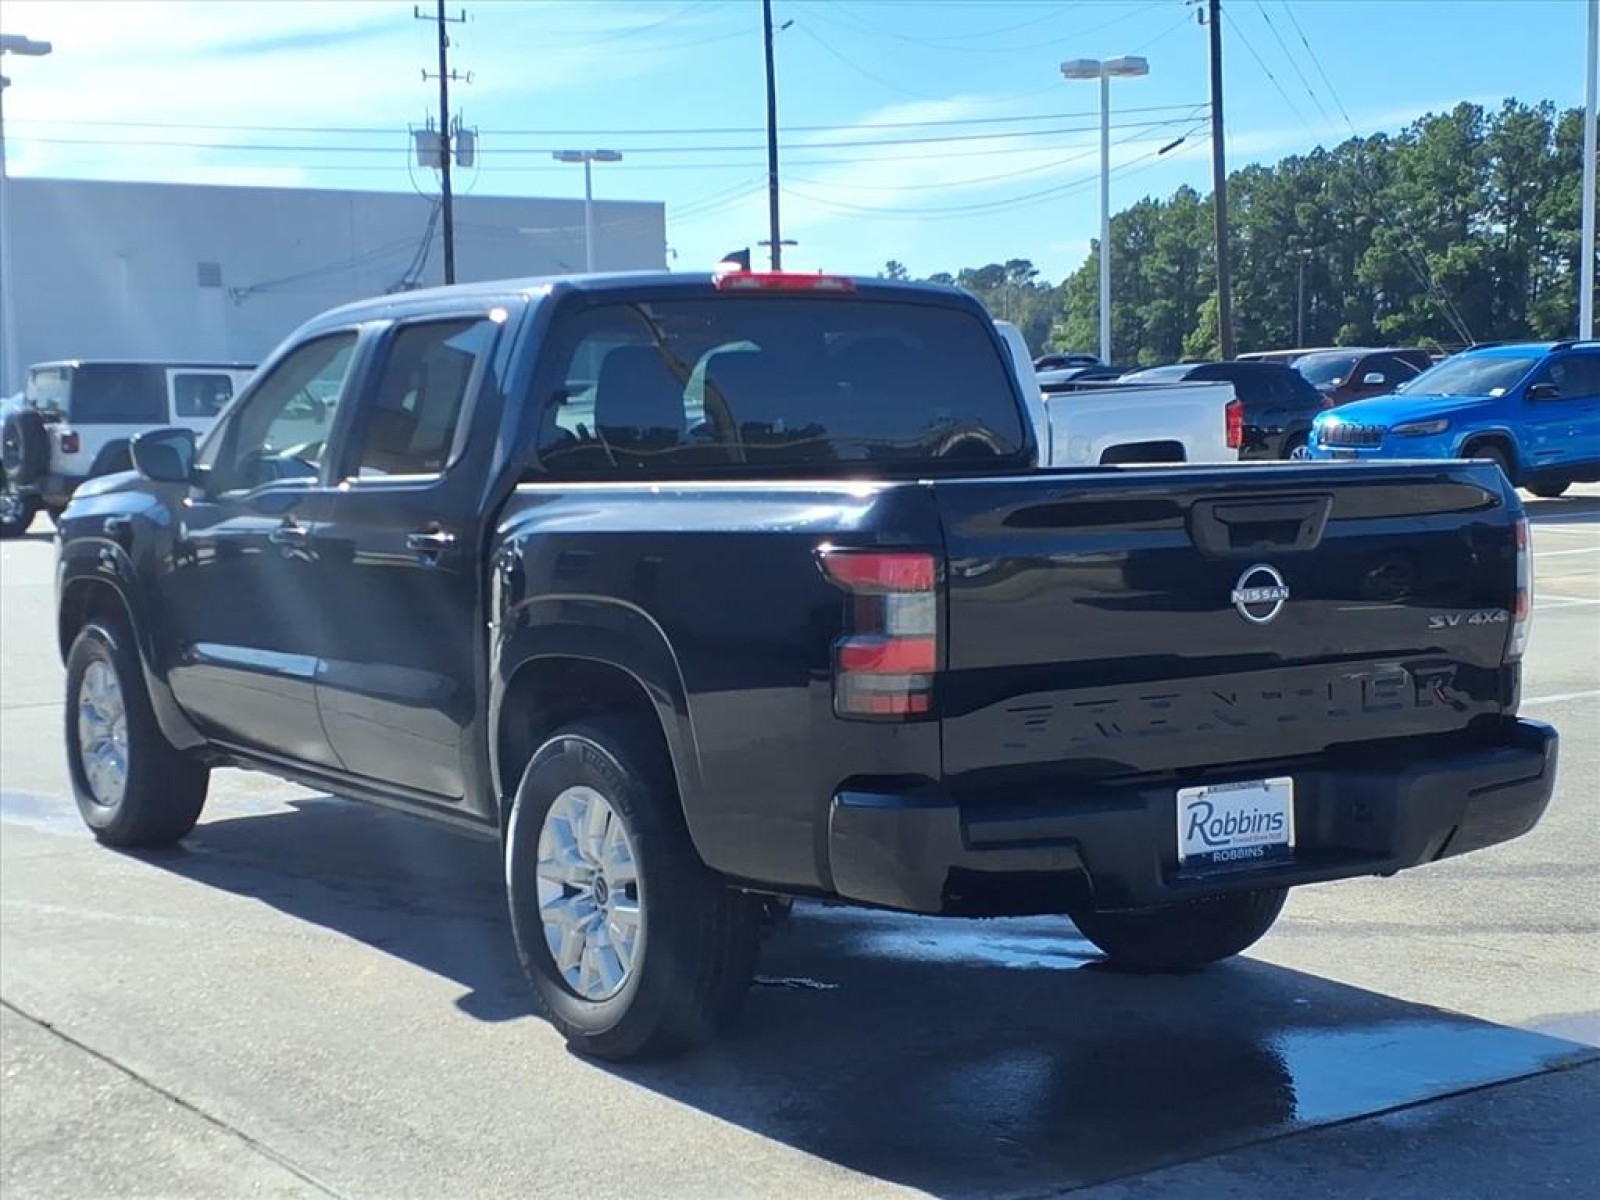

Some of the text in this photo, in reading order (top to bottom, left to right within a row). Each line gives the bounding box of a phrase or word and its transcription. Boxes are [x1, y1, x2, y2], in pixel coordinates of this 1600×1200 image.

[1232, 588, 1289, 602] NISSAN
[1428, 614, 1461, 629] SV
[1187, 800, 1284, 846] Robbins
[1213, 847, 1264, 862] ROBBINS
